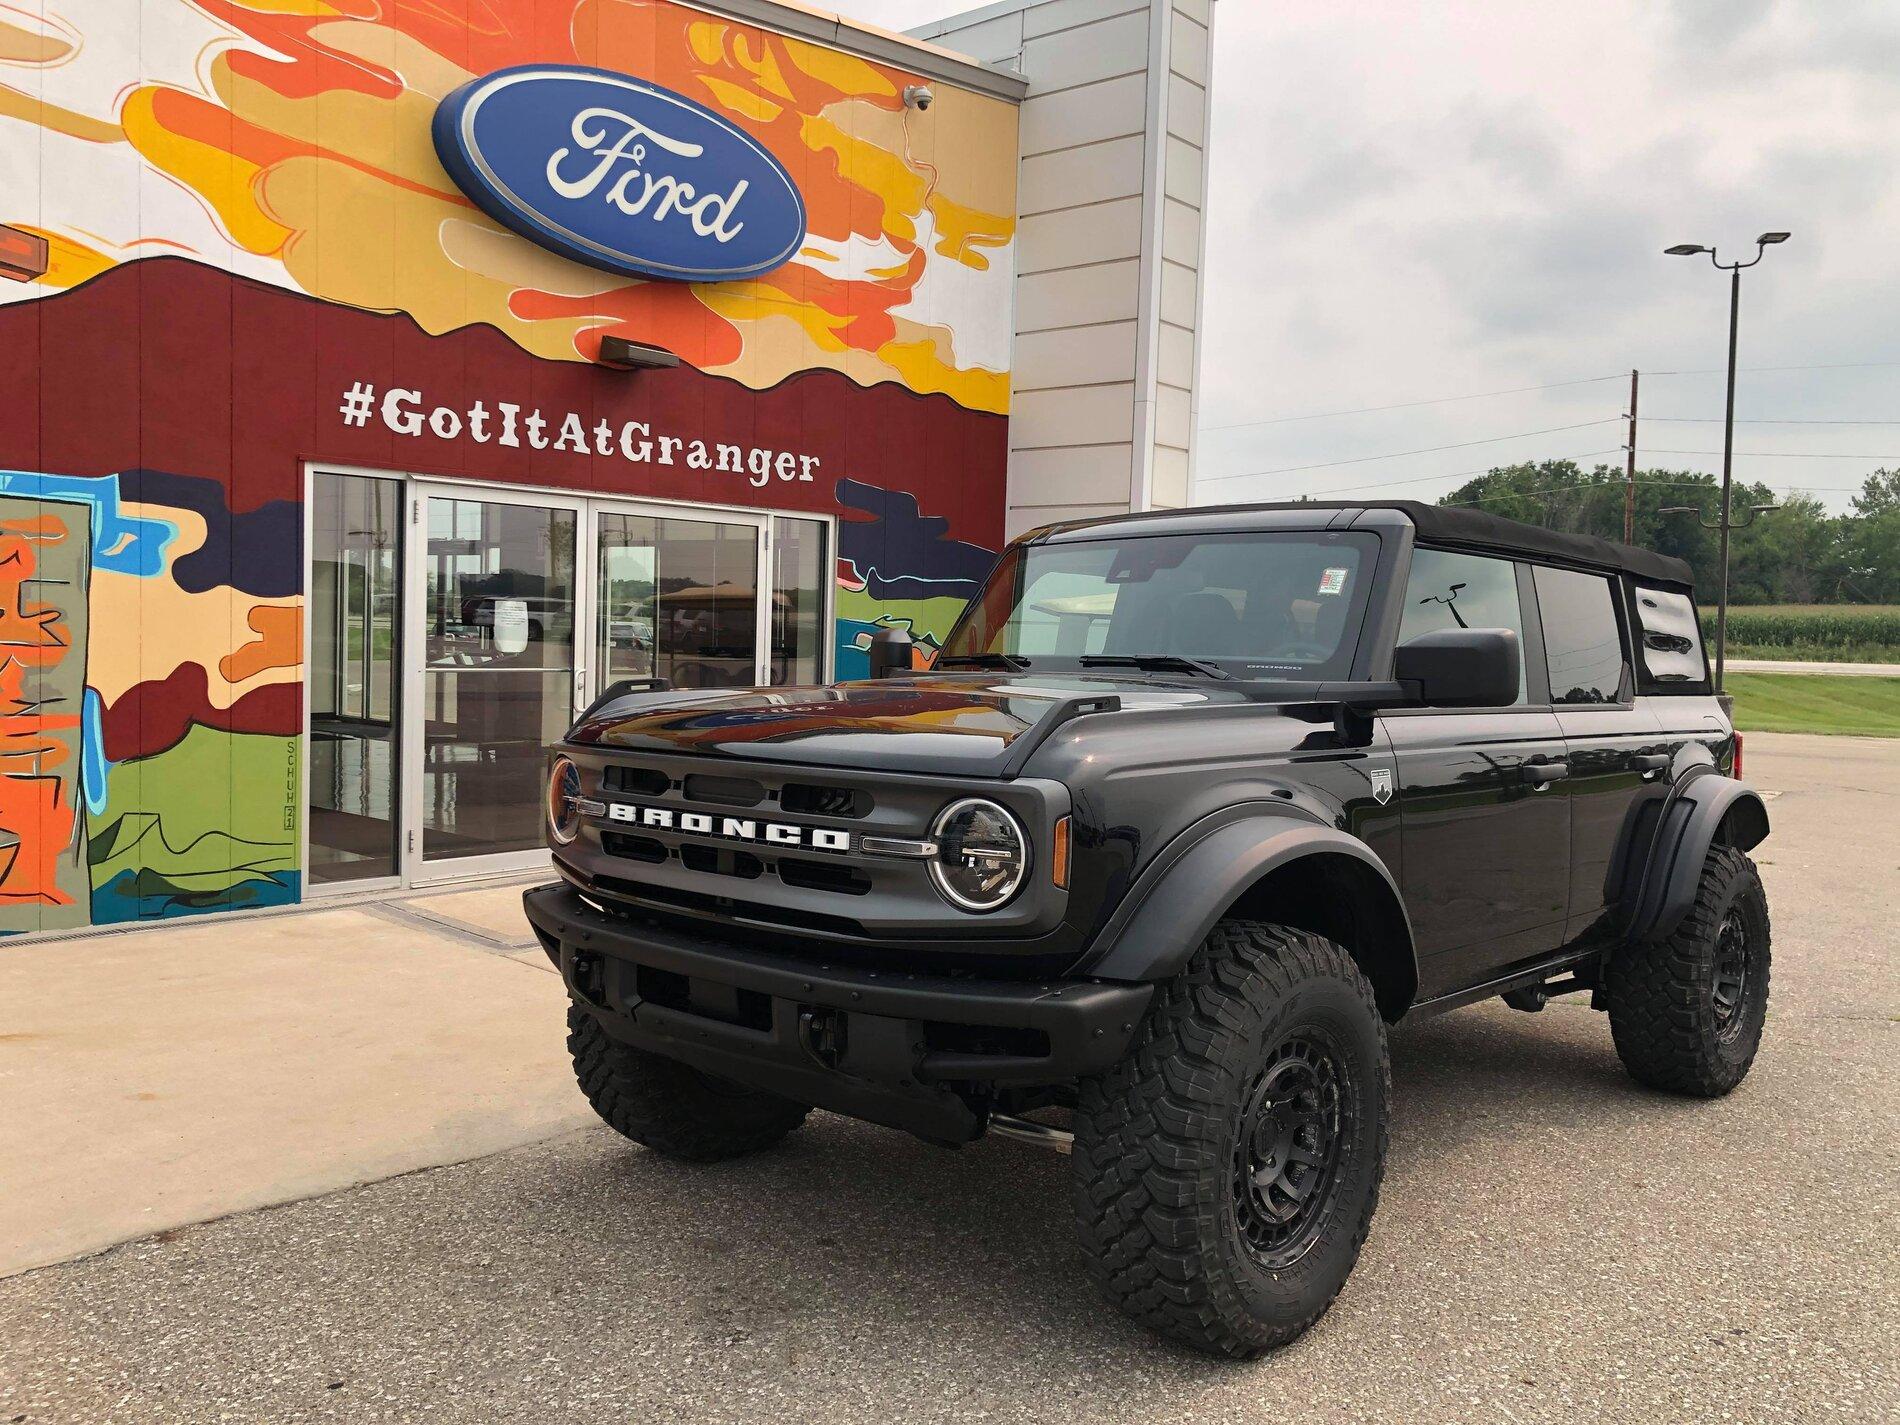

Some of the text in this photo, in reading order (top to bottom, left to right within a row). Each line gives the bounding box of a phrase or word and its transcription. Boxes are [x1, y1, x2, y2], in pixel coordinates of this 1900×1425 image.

[546, 107, 749, 243] Ford
[339, 381, 820, 487] #GotItAtGranger
[286, 741, 295, 802] SCHUH
[609, 803, 850, 851] BRONCO
